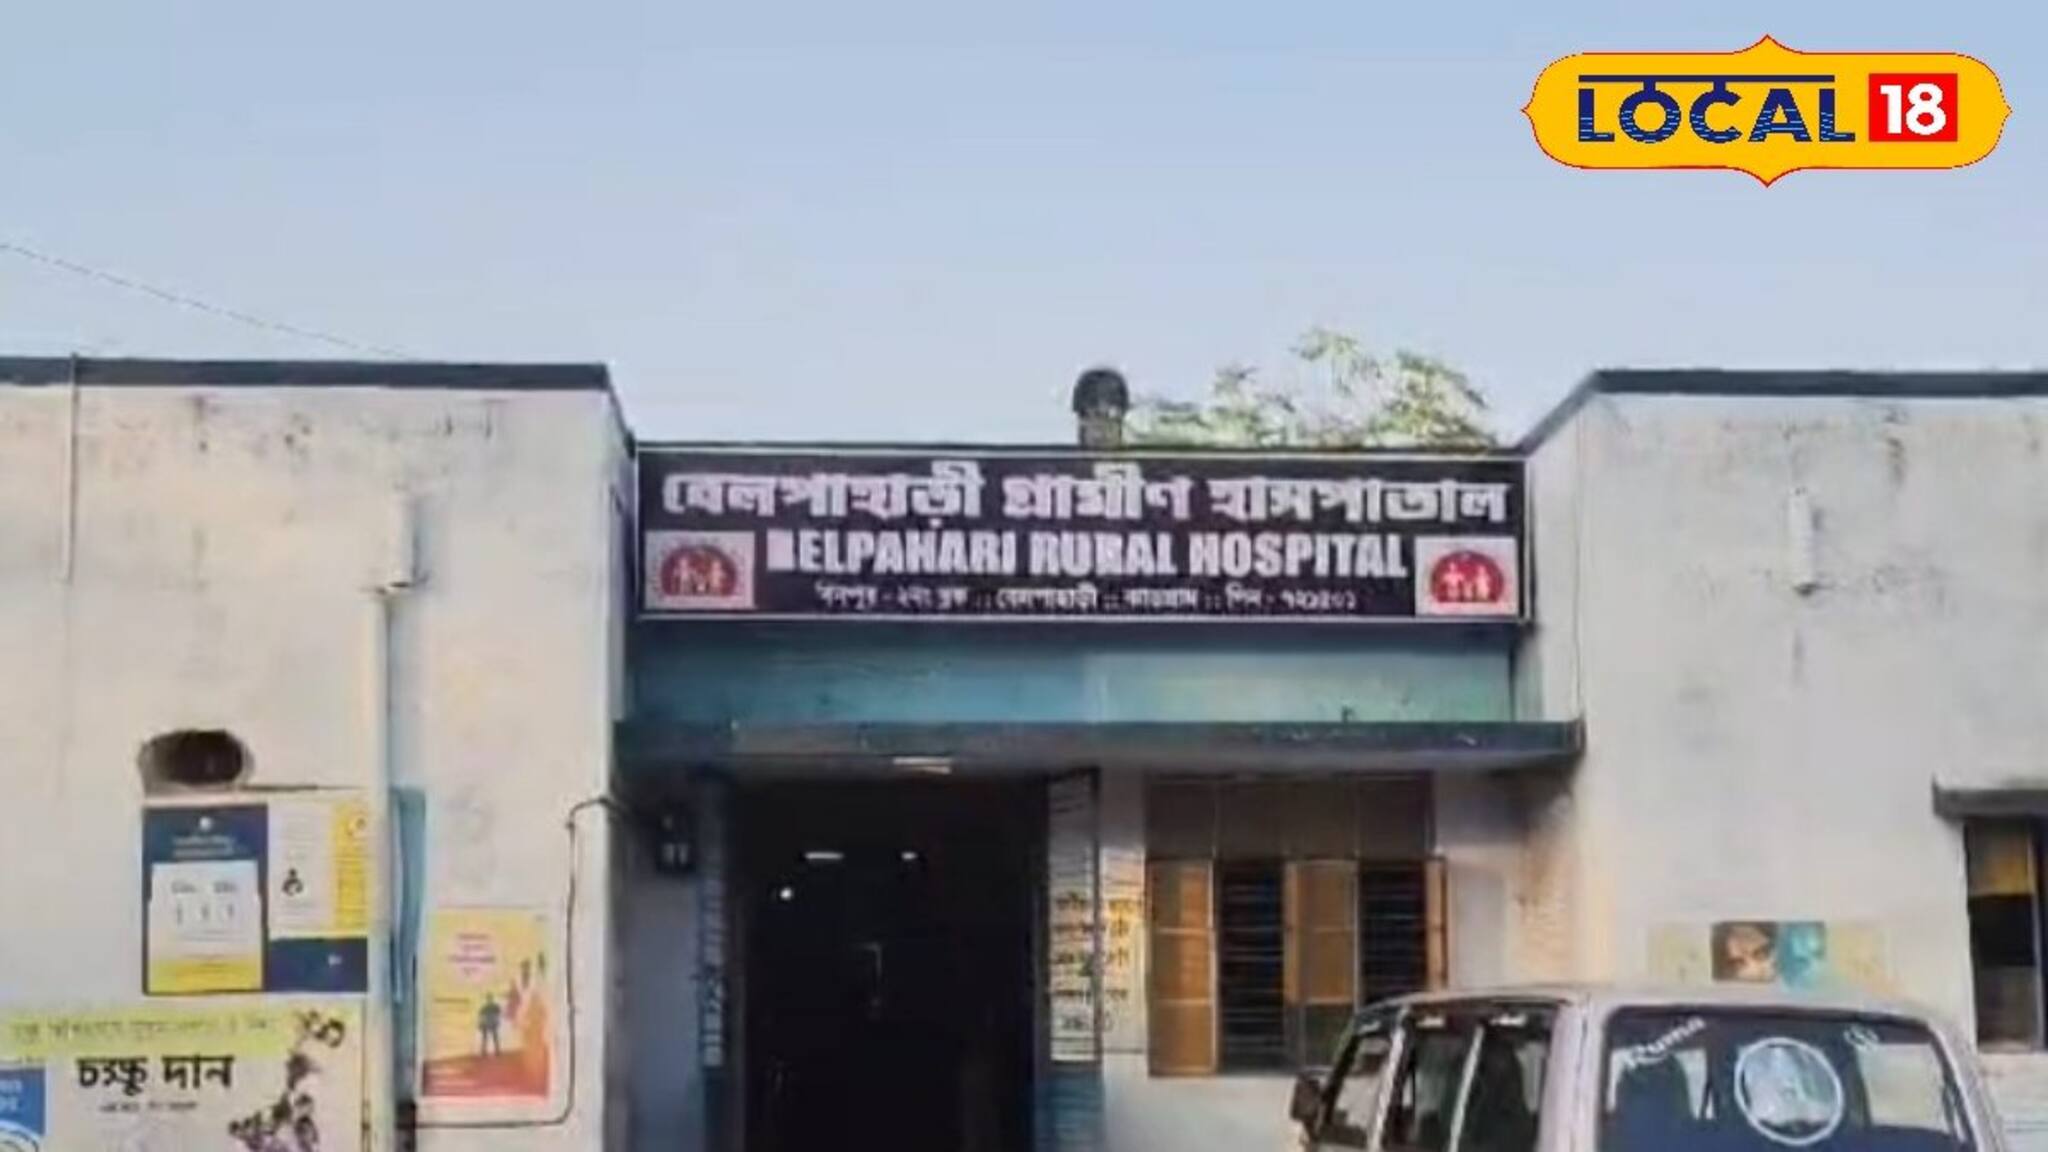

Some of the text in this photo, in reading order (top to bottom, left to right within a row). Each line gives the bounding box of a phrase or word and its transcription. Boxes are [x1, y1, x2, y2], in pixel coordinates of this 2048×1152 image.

[663, 460, 1509, 527] বেলপাহাড়ী গ্রামীণ হাসপাতাল
[1029, 531, 1177, 577] RURAL
[1189, 532, 1407, 578] HOSPITAL
[161, 1054, 234, 1089] দান
